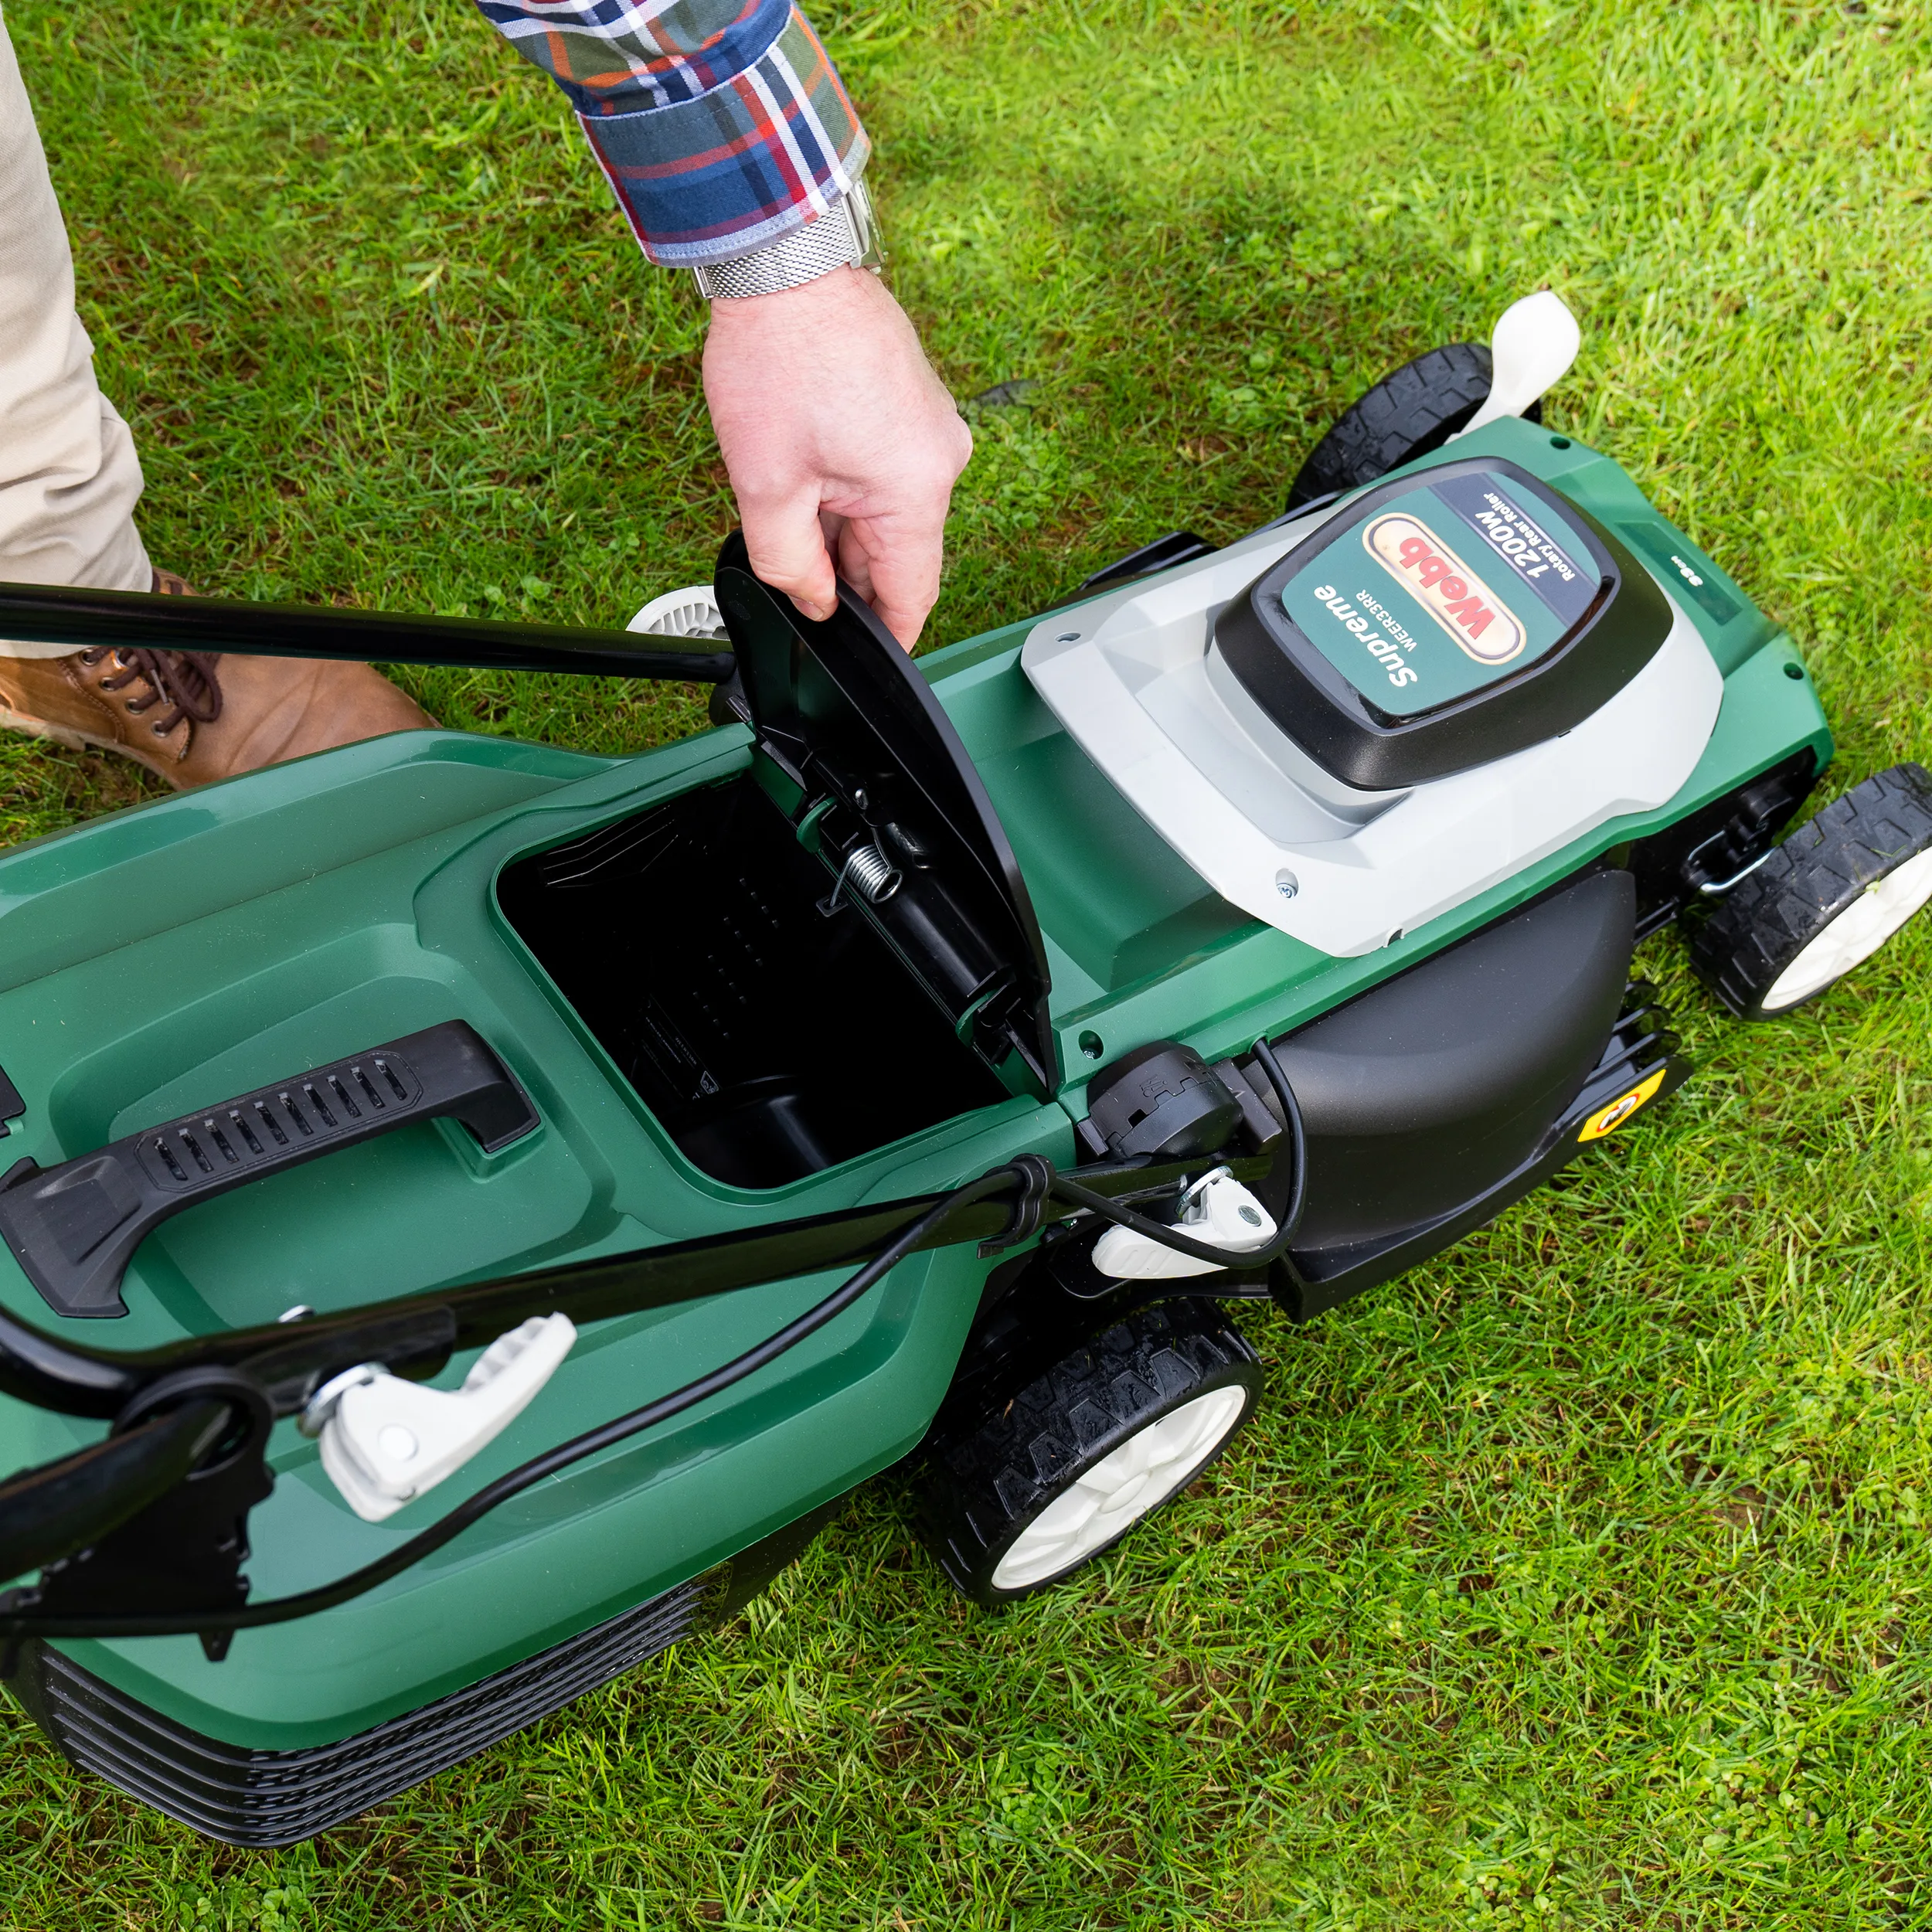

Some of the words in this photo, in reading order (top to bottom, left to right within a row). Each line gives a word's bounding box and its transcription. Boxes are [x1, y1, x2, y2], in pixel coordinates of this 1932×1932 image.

[1483, 492, 1518, 522] Roller
[1513, 521, 1542, 546] Rear
[1538, 544, 1576, 581] Rotary
[1399, 537, 1496, 640] Webb
[1314, 584, 1418, 687] Supreme
[1355, 589, 1417, 652] WEER33RR
